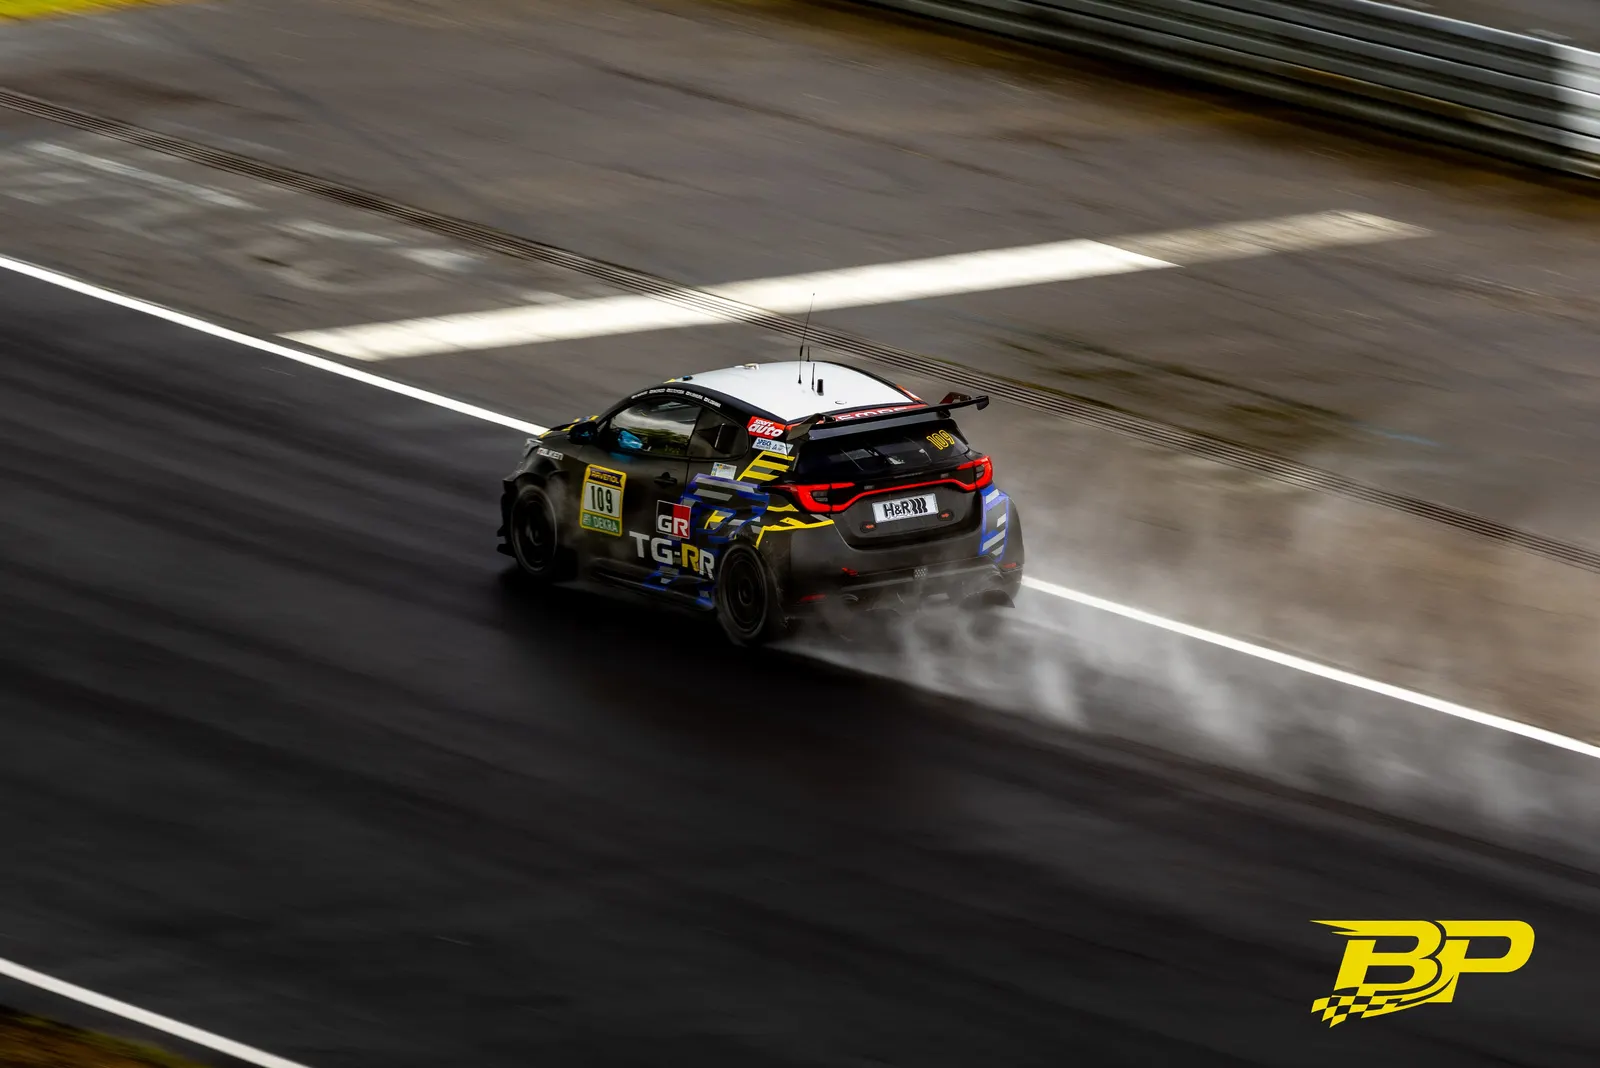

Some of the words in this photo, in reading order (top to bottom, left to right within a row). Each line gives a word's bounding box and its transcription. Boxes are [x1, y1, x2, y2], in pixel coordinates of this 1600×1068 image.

[748, 423, 784, 437] auto
[926, 429, 955, 451] 109
[590, 470, 619, 484] RAVENOL
[590, 485, 613, 513] 109
[593, 516, 619, 533] DEKRA
[657, 513, 690, 537] GR
